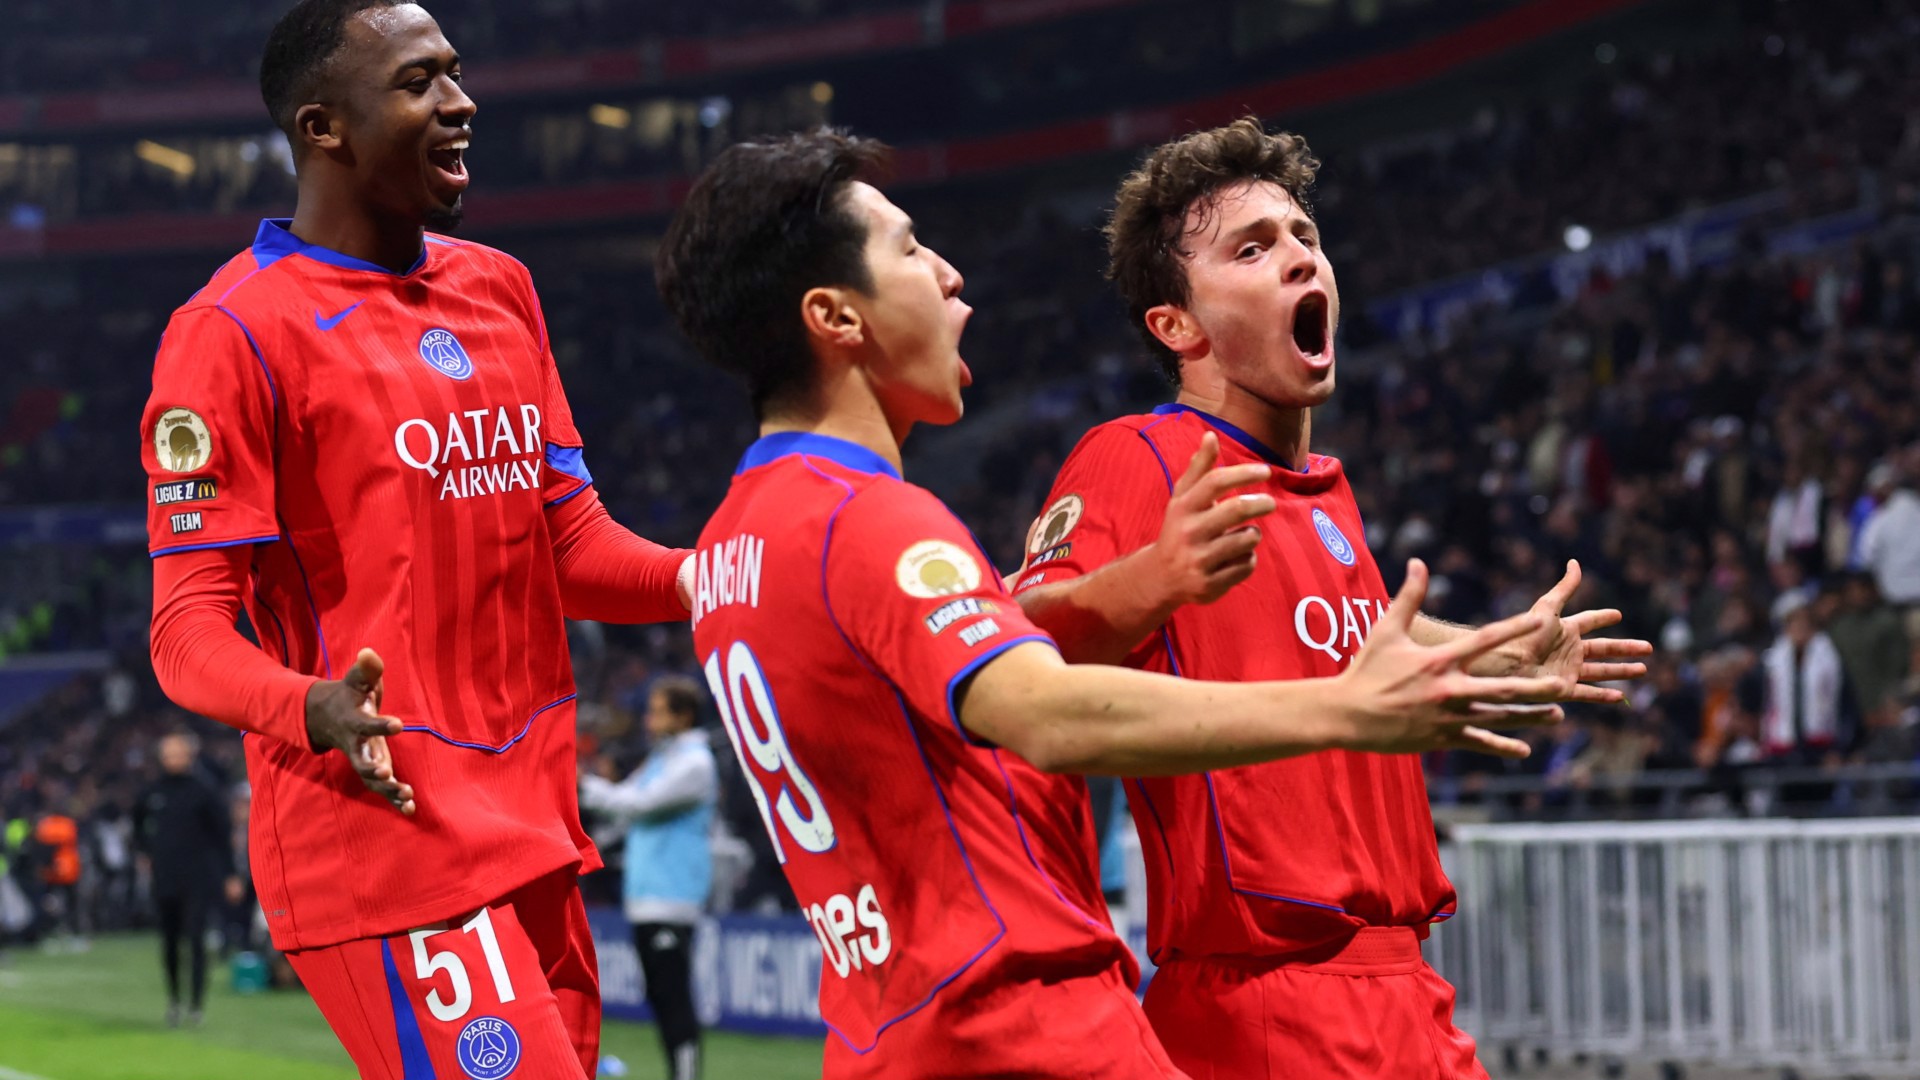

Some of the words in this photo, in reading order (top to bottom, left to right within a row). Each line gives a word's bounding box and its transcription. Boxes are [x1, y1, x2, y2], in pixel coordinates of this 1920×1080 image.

[423, 332, 453, 349] PARIS
[394, 403, 542, 479] QATAR
[155, 484, 184, 504] LIGUE
[170, 512, 202, 533] 1TEAM
[1294, 595, 1391, 663] QAT
[704, 640, 838, 865] 19
[408, 906, 516, 1022] 51
[803, 883, 891, 979] oes
[463, 1020, 503, 1041] PARIS
